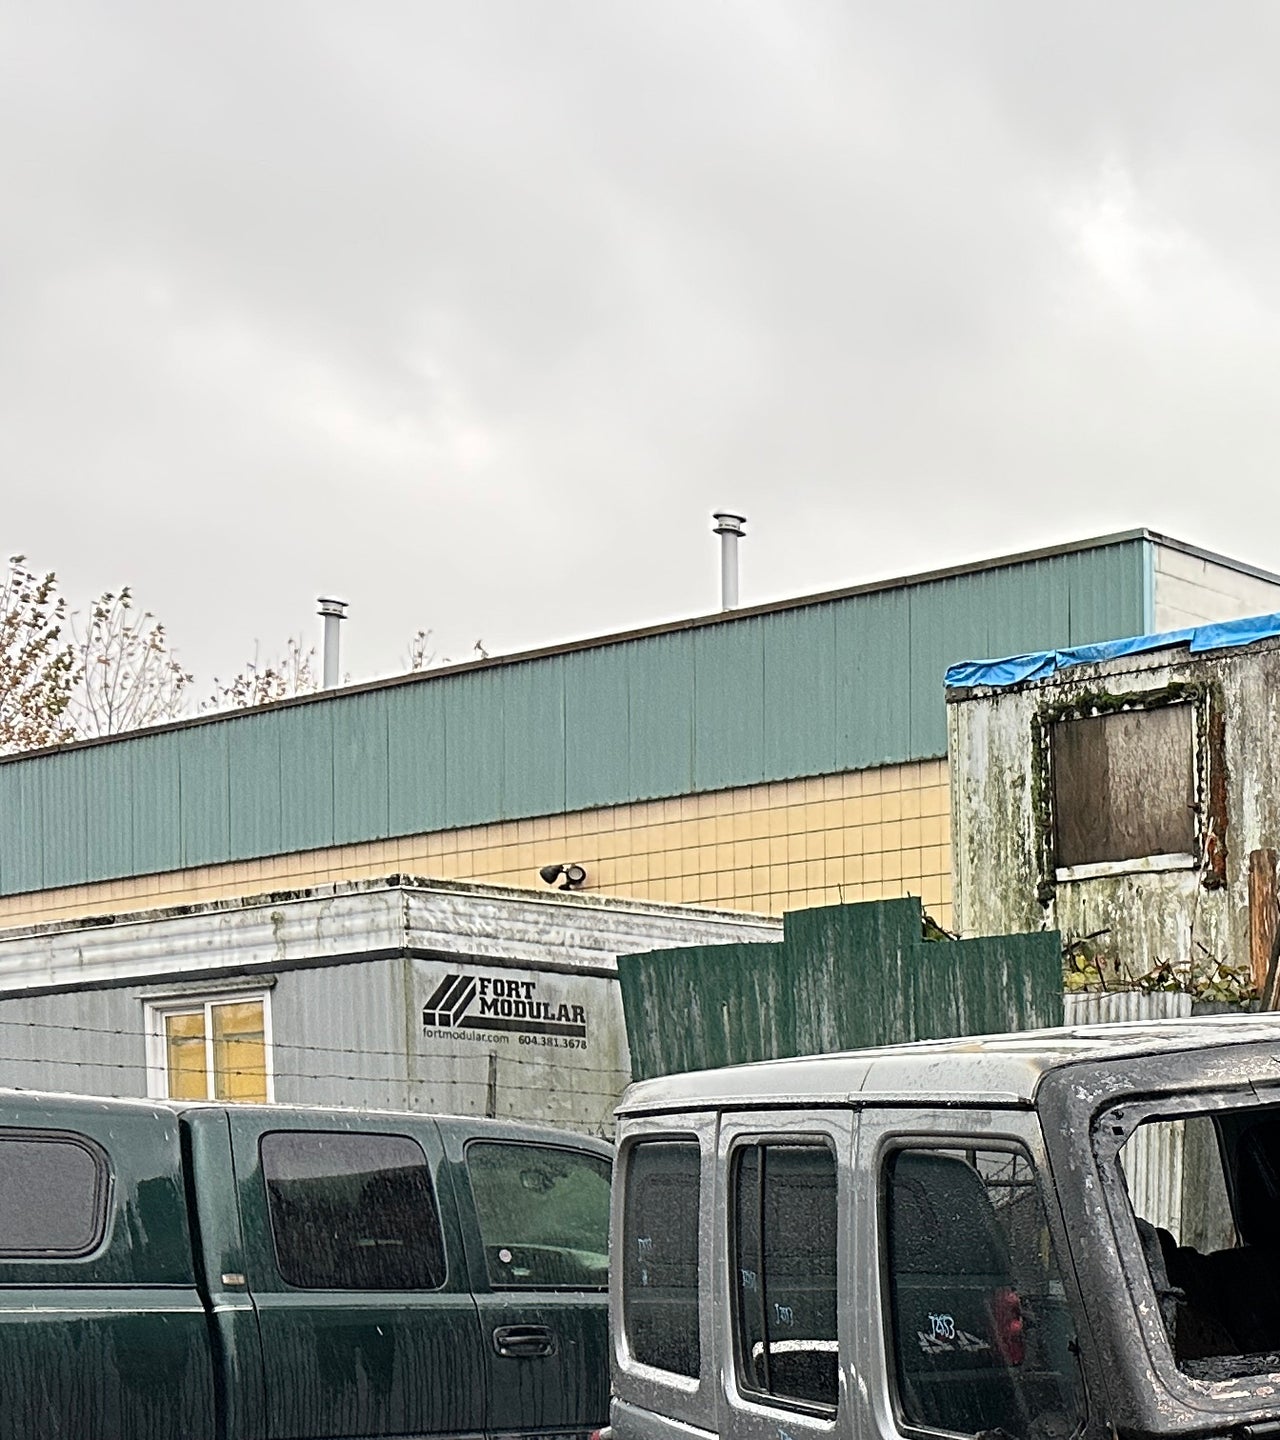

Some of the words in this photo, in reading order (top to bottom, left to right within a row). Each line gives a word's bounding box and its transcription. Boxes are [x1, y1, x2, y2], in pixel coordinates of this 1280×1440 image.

[478, 977, 536, 999] FORT
[479, 997, 586, 1023] MODULAR
[423, 1027, 509, 1044] fortmodular.com
[518, 1034, 587, 1050] 604.381.3678
